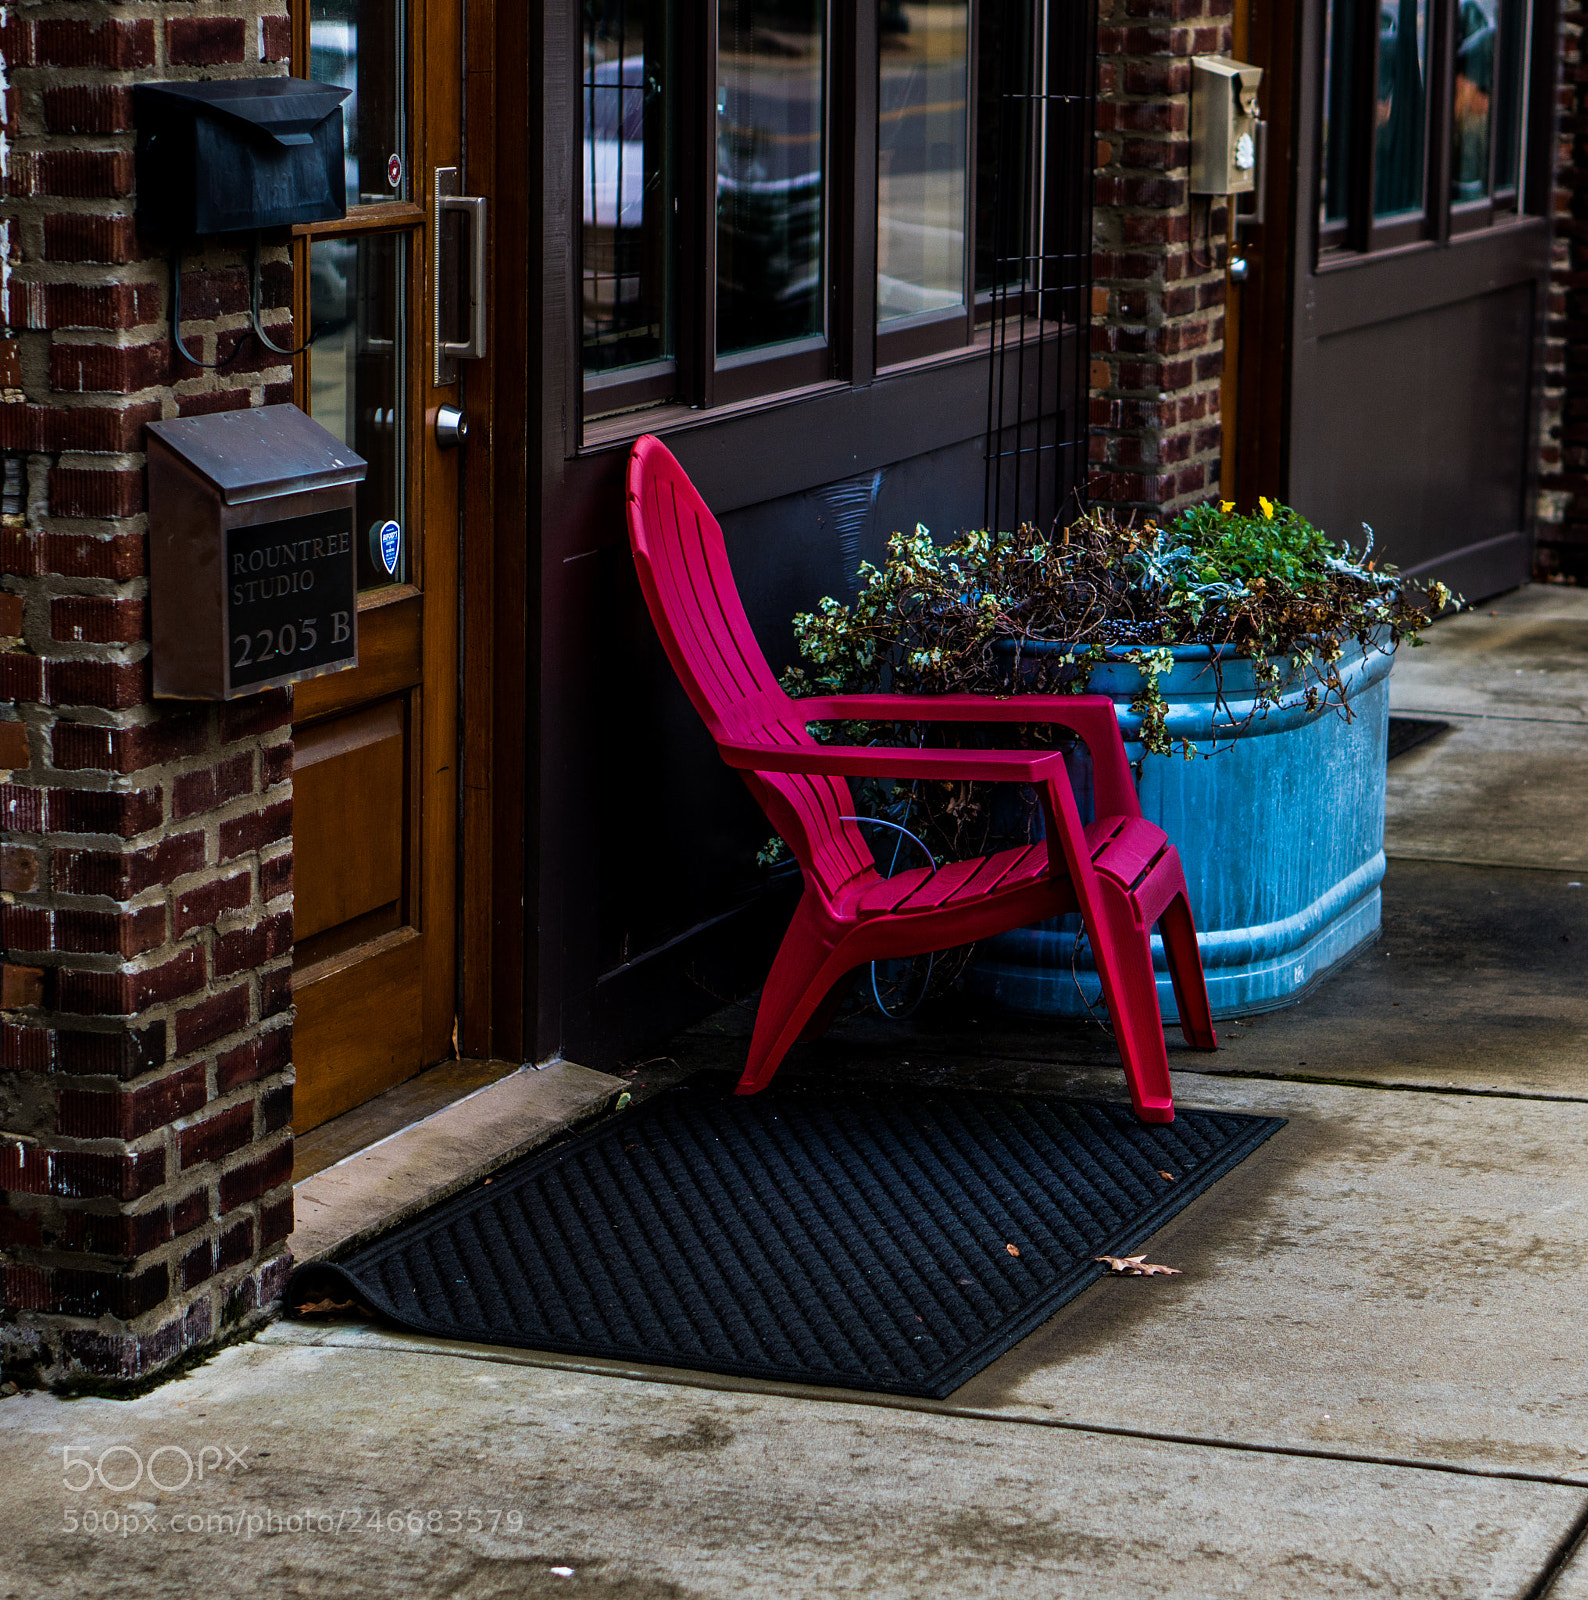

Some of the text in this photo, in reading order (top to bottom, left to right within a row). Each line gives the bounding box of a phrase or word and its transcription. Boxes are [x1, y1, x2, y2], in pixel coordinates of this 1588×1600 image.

[232, 532, 350, 575] ROUNTREE
[233, 569, 315, 606] STUDIO
[233, 610, 351, 668] 2205 B
